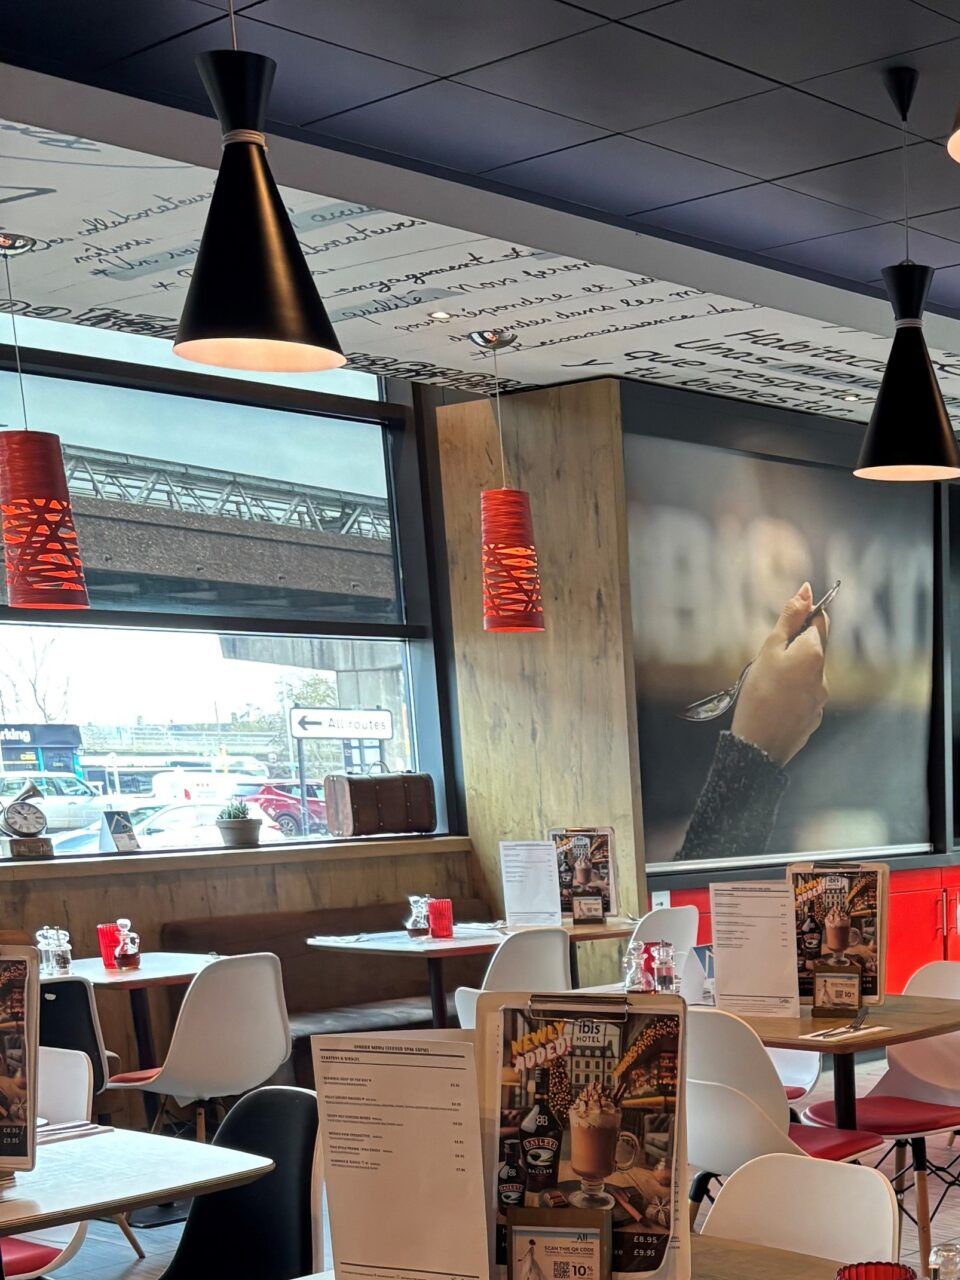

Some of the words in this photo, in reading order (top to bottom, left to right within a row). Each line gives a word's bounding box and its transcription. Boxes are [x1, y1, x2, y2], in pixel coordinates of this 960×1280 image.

[620, 297, 665, 308] les
[623, 349, 706, 368] que
[674, 337, 782, 365] Unas
[624, 365, 676, 380] tu
[679, 376, 855, 417] bienestar.
[328, 717, 344, 729] All
[348, 720, 386, 730] routes
[0, 727, 31, 743] rking
[511, 1021, 566, 1054] NEWLY
[578, 1021, 601, 1035] ibis
[513, 1036, 573, 1073] ADDED!
[576, 1035, 601, 1044] HOTEL
[523, 1137, 559, 1151] BAILEYS
[633, 1235, 658, 1244] £8.95
[633, 1249, 656, 1257] £9.95
